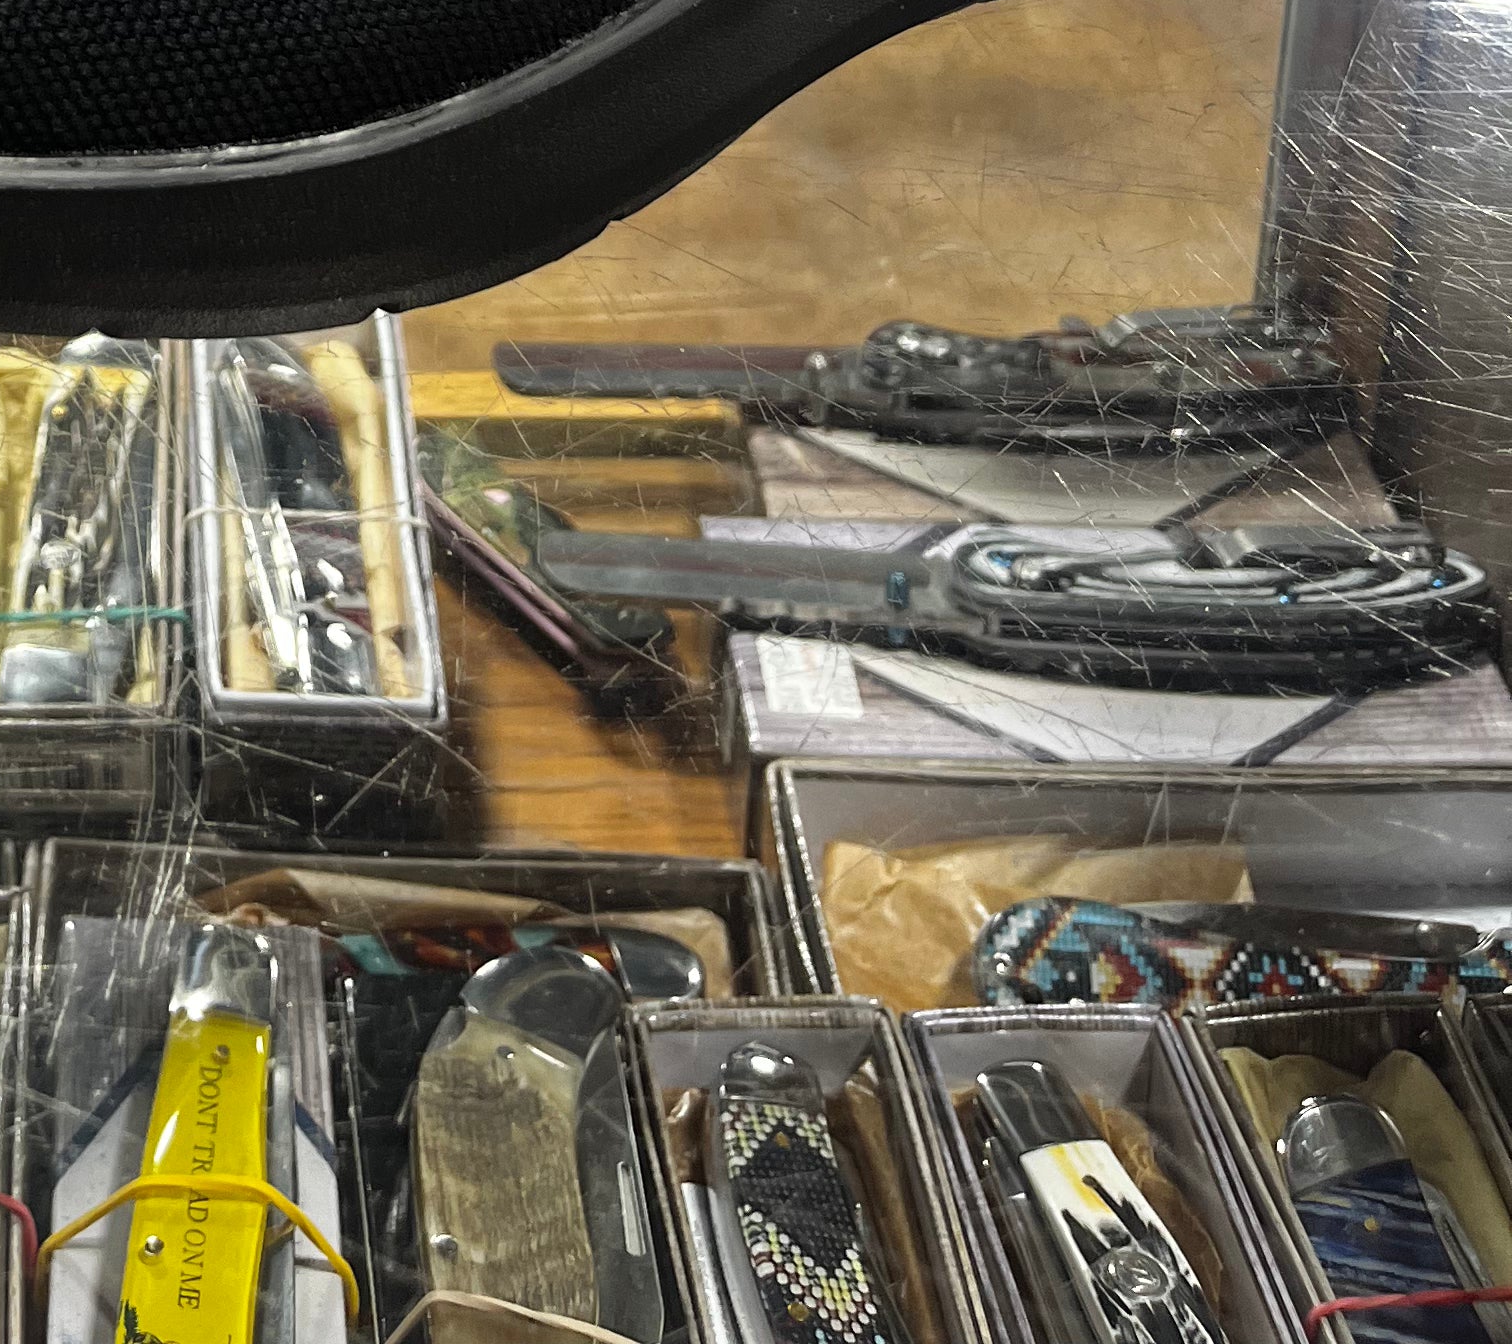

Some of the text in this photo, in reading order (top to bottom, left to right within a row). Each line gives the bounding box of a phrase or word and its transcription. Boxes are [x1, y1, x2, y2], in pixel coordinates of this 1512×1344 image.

[177, 1064, 222, 1310] DONT TRAD ON ME
